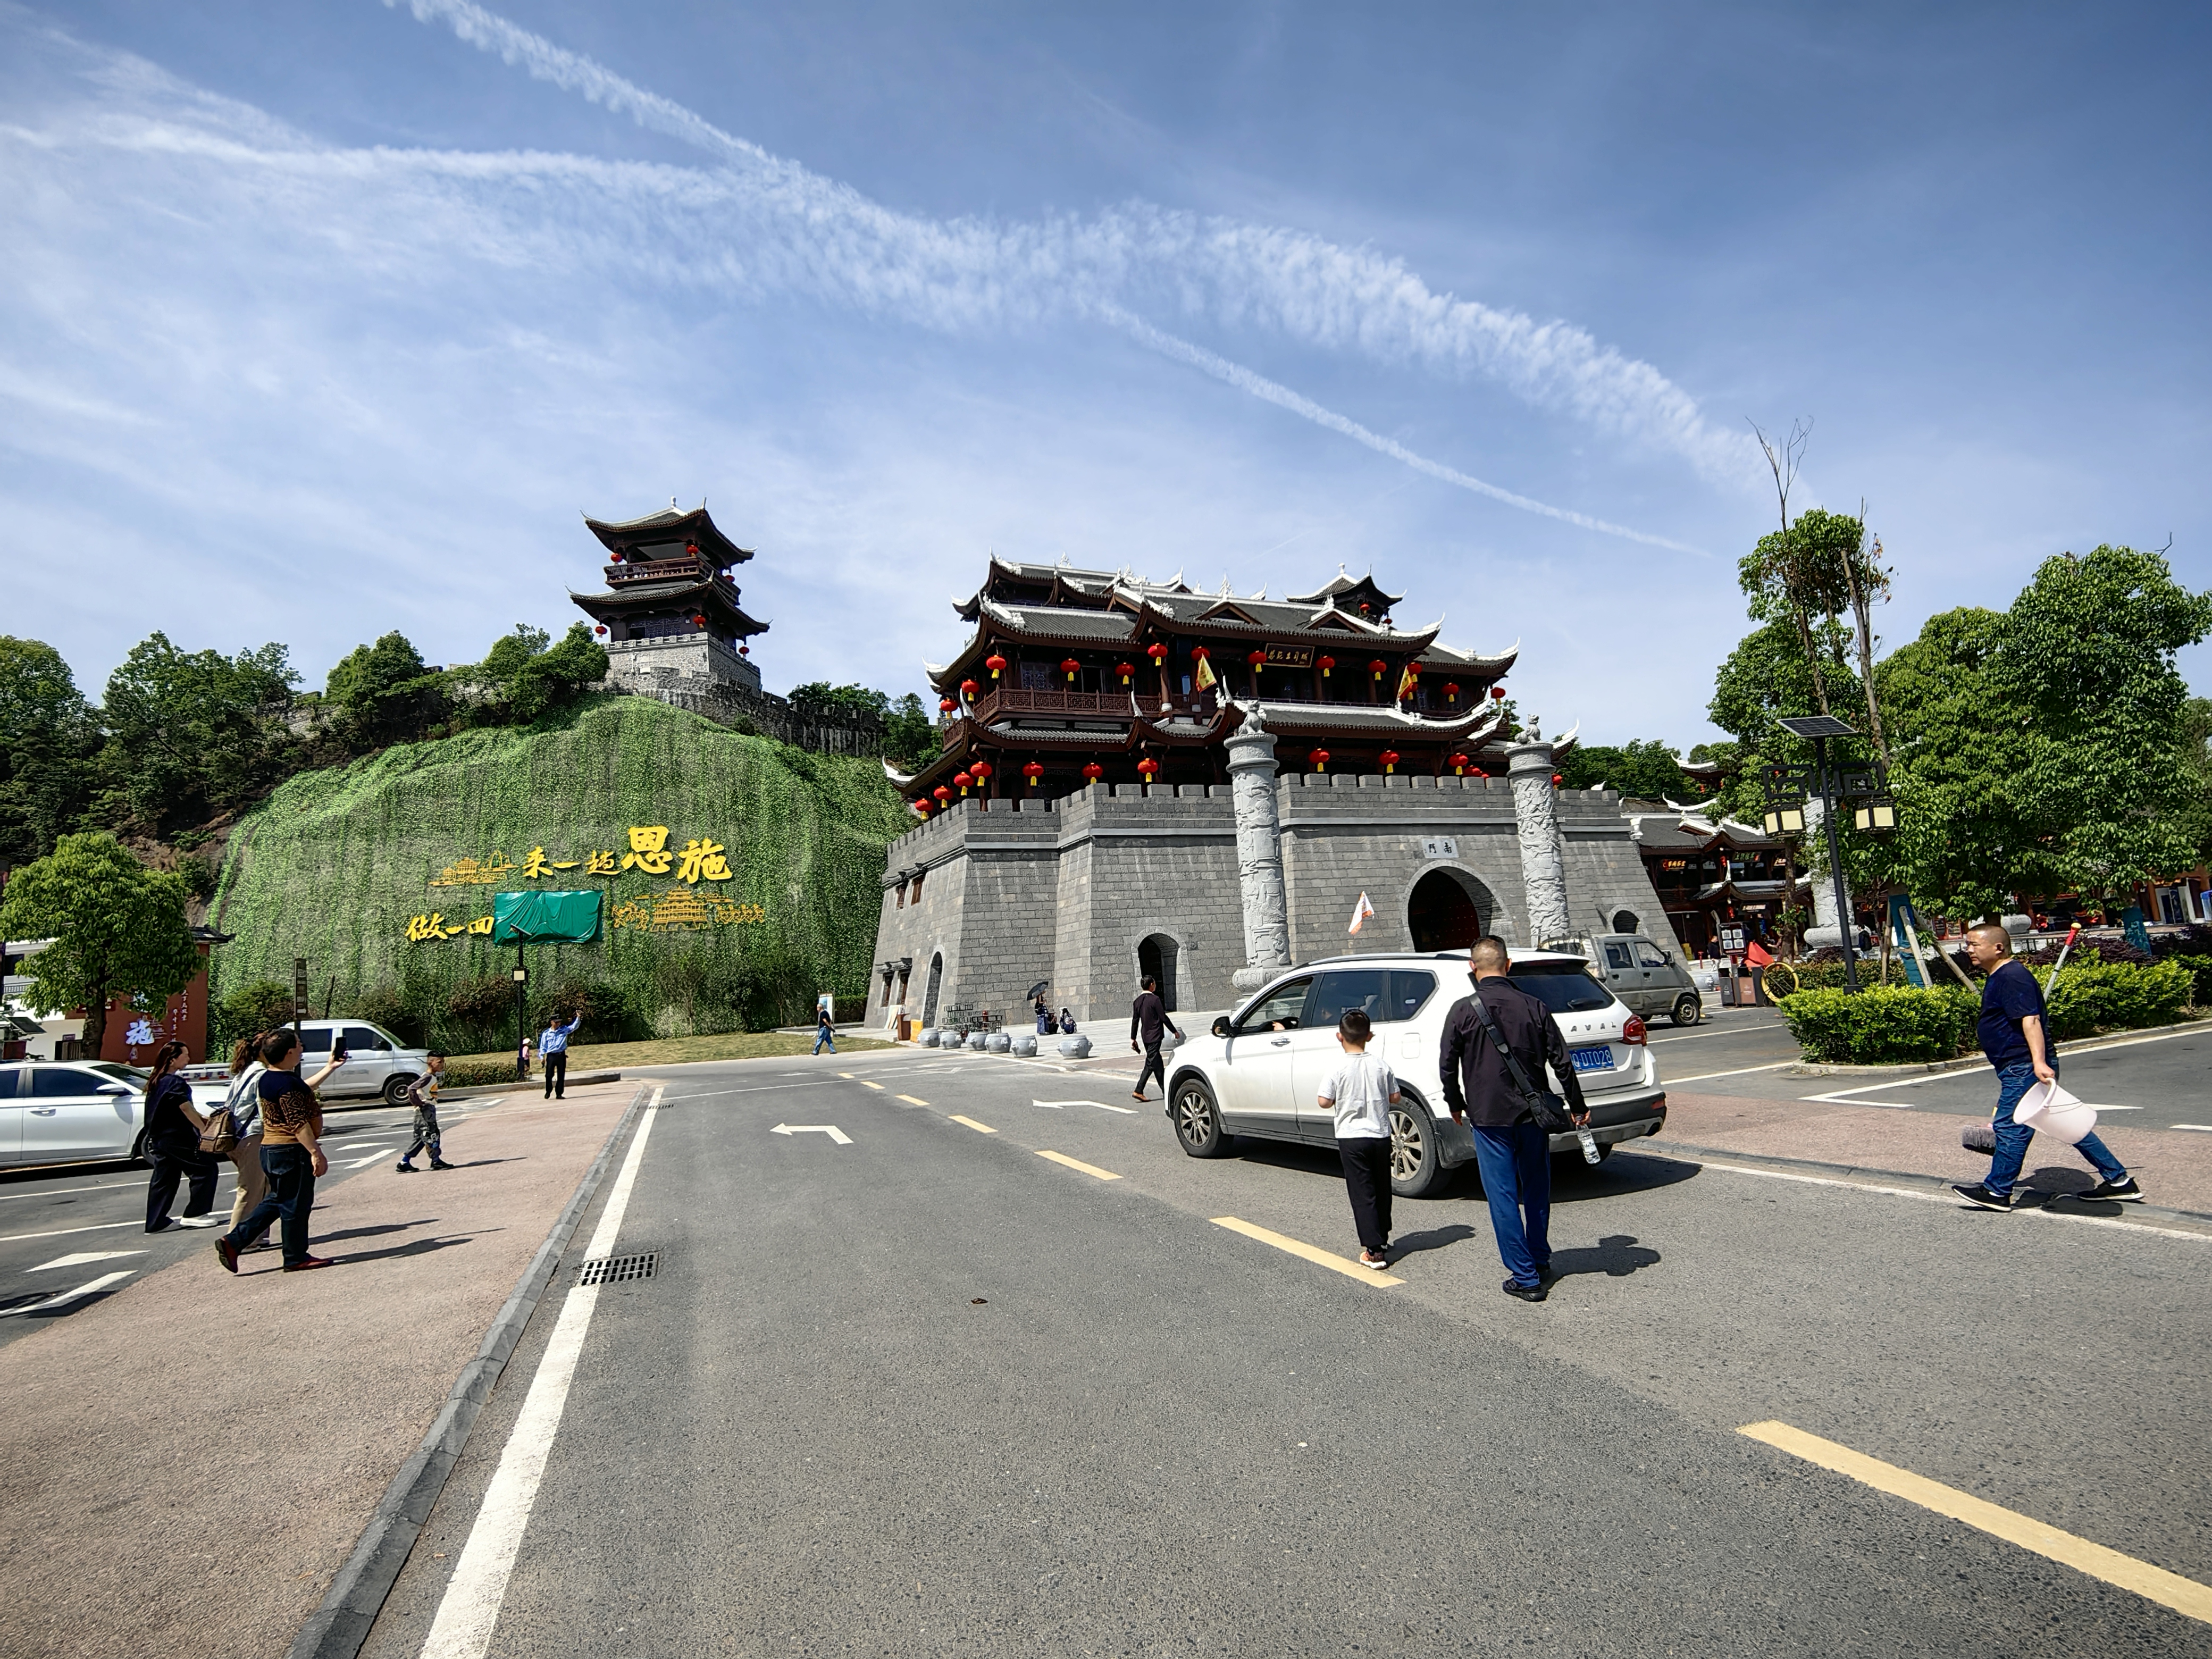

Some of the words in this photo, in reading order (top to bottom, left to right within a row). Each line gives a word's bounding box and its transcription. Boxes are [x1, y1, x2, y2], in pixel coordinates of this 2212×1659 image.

[523, 826, 733, 884] 来一趟恩施
[1571, 1021, 1616, 1032] AVAL
[1570, 1049, 1613, 1068] Q·DT028
